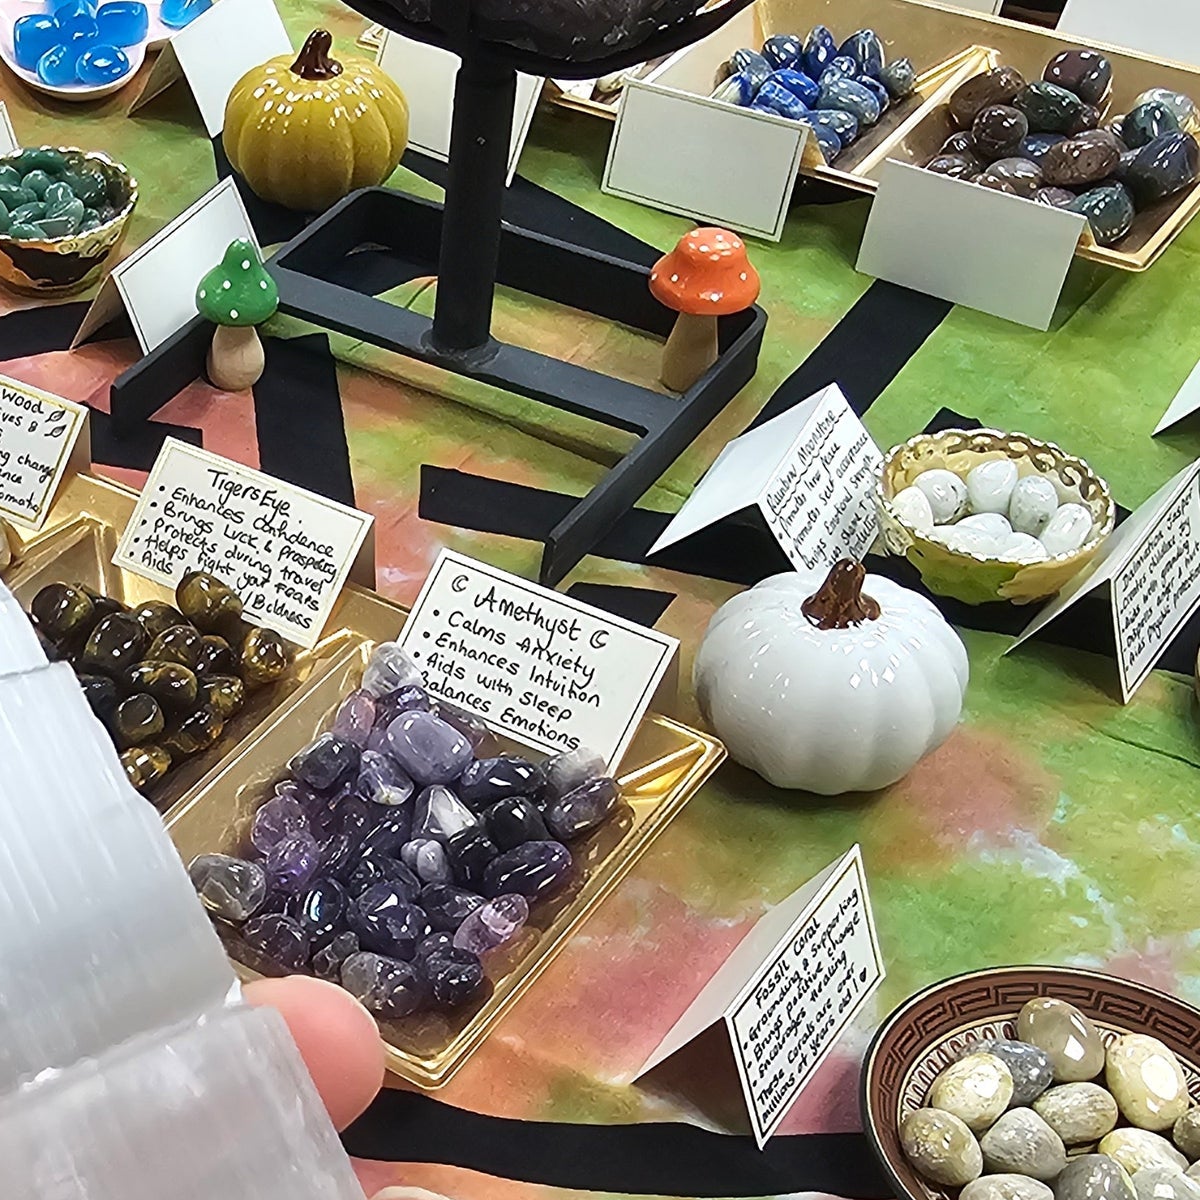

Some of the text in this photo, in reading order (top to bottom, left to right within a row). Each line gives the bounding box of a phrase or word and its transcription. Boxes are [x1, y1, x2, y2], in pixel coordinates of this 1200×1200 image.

[163, 502, 214, 535] Brings
[171, 486, 245, 524] Enhances
[141, 551, 173, 575] Aids
[144, 536, 189, 561] Helps
[225, 545, 272, 580] during
[280, 567, 323, 595] travel
[447, 610, 506, 646] Calms
[474, 585, 582, 649] Amethyst
[426, 651, 466, 681] Aids
[476, 674, 513, 697] with
[435, 631, 600, 708] Enhances Intuition
[421, 670, 581, 750] Balances Emotions
